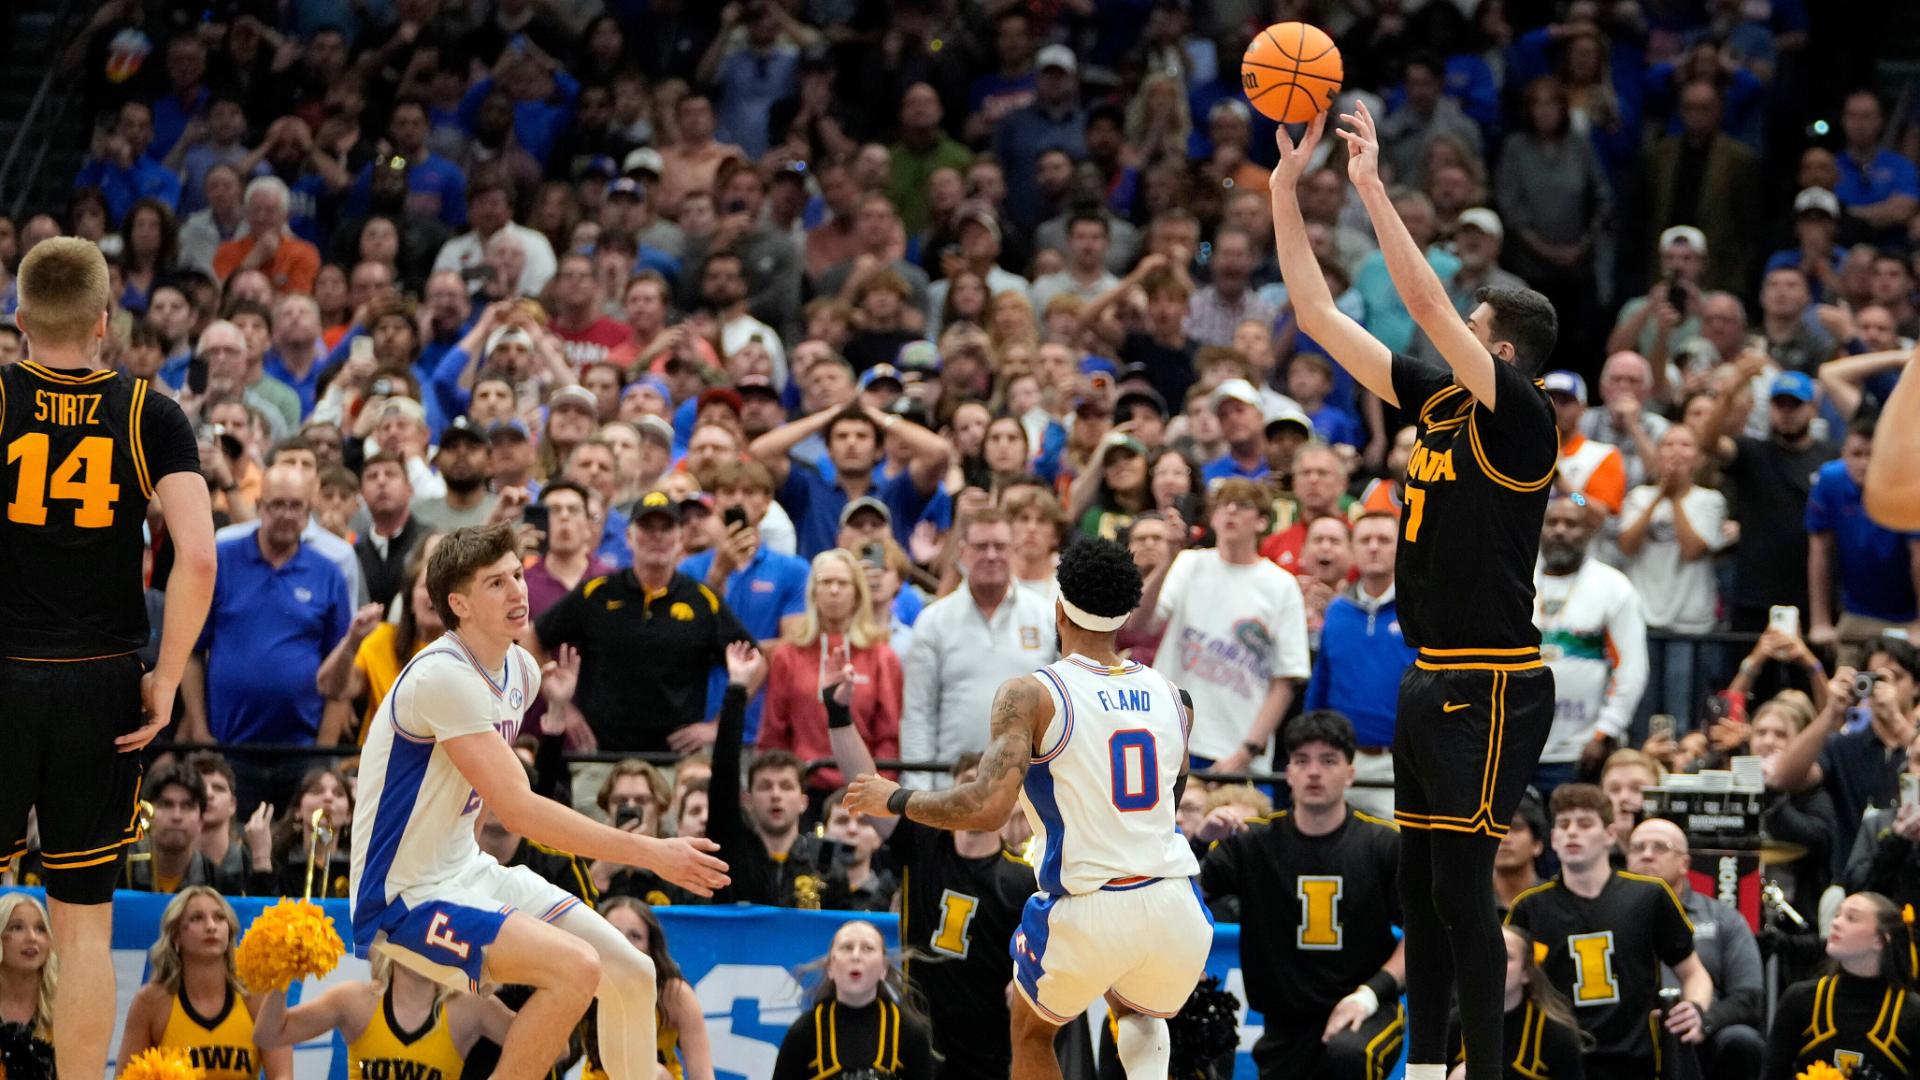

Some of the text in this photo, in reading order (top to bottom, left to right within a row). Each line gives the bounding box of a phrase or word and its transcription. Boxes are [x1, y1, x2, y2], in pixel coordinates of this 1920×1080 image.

[34, 388, 102, 426] STIRTZ
[7, 432, 120, 528] 14
[1404, 482, 1426, 542] 7
[1097, 689, 1151, 712] FLAND
[1108, 728, 1160, 812] 0
[425, 911, 471, 960] F
[930, 888, 979, 960] I
[1297, 875, 1343, 950] I
[1567, 930, 1620, 1007] I
[360, 1057, 444, 1080] IOWA
